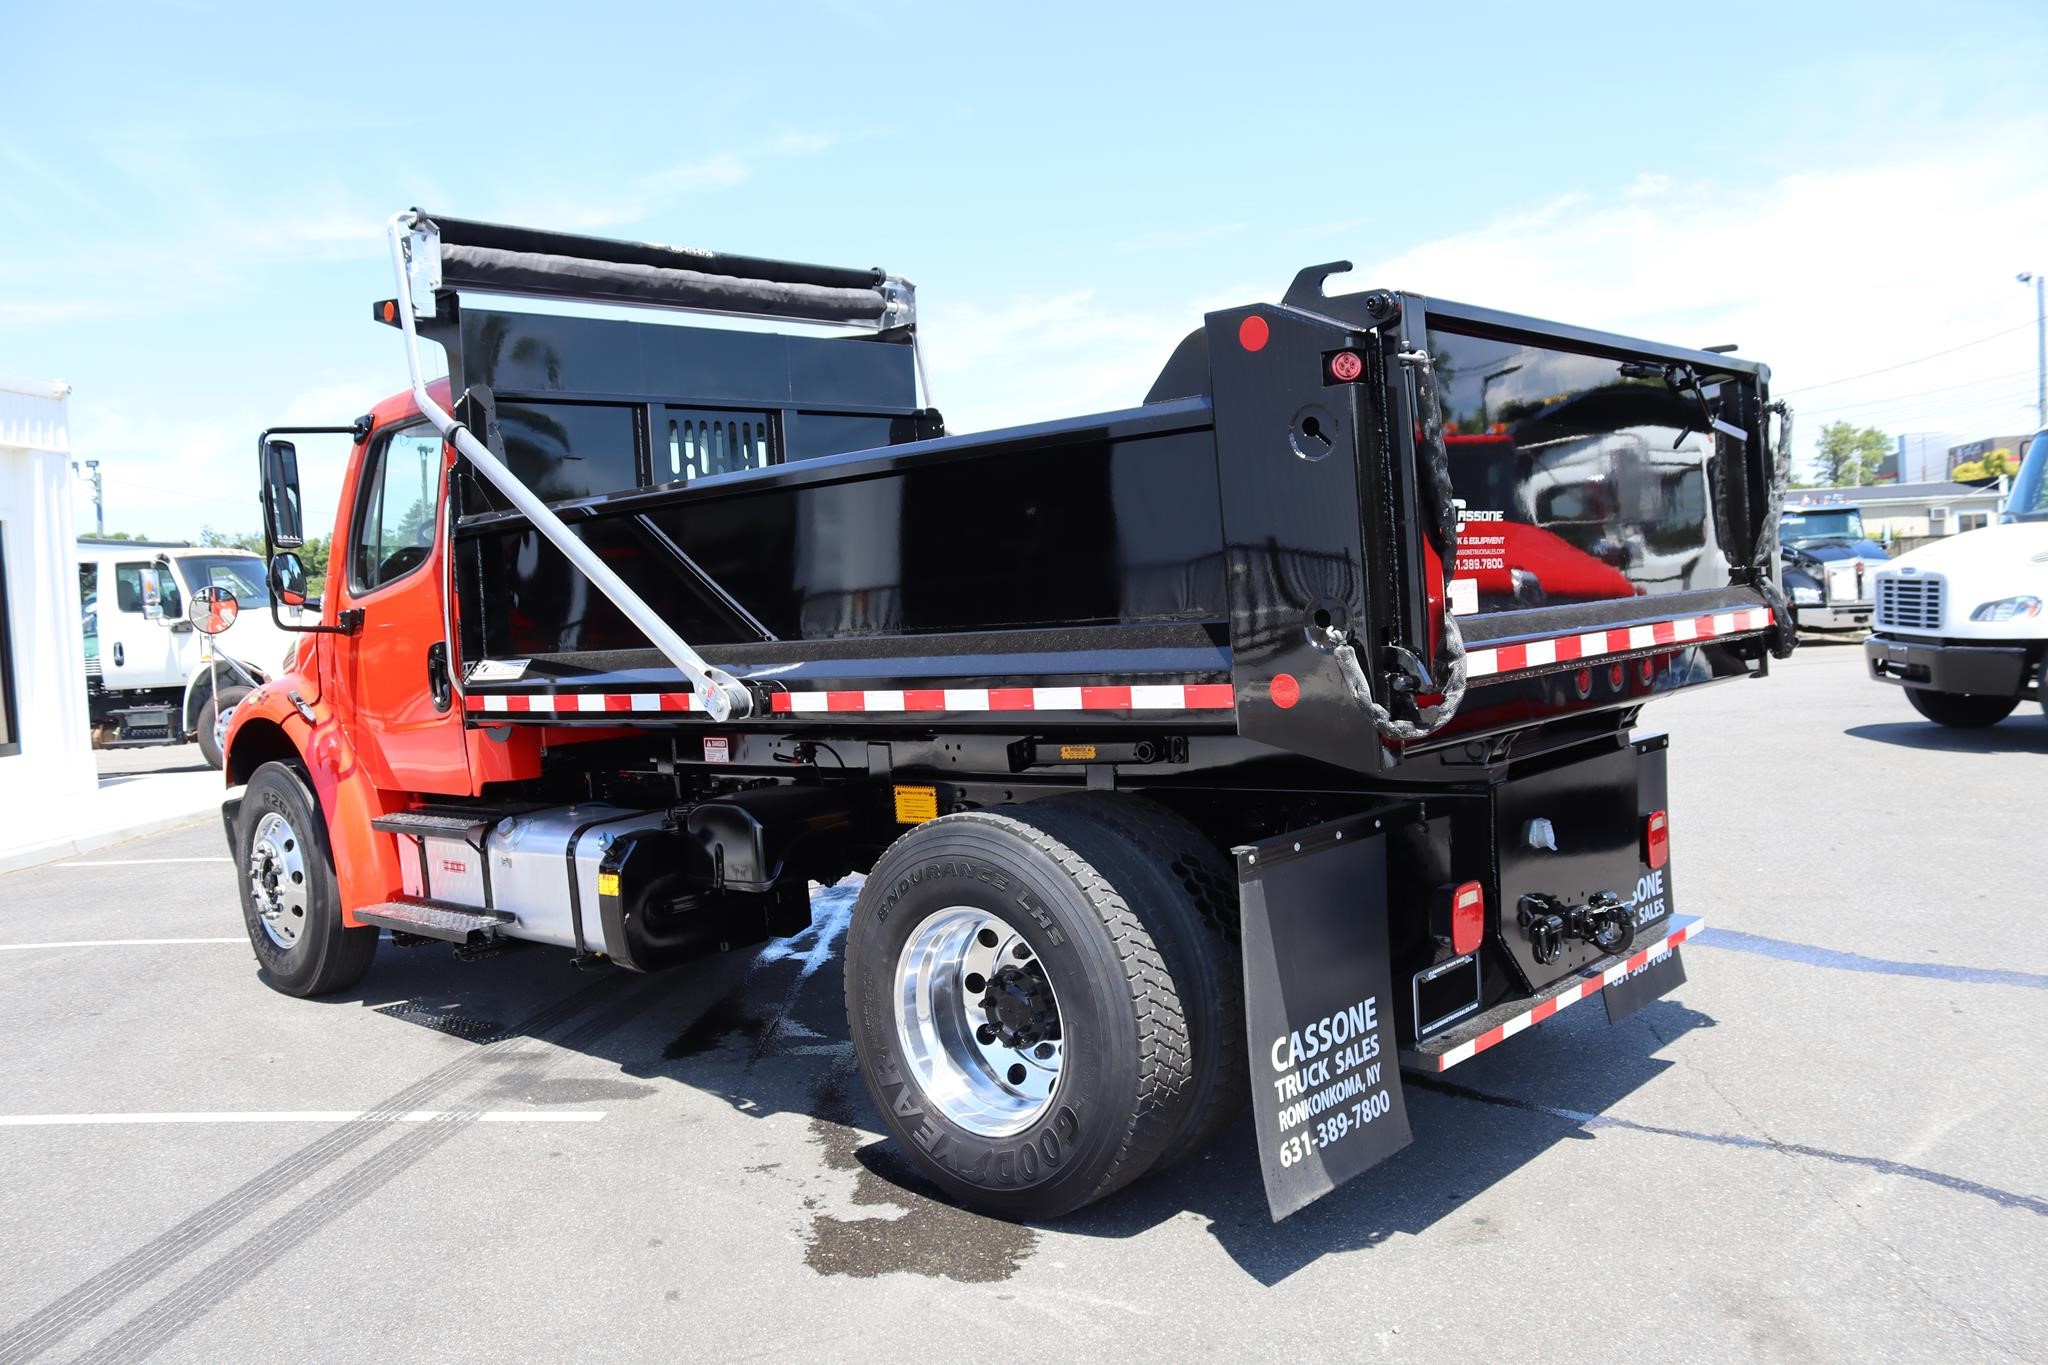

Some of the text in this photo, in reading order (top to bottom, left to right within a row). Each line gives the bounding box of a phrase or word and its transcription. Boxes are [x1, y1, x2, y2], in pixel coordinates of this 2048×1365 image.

[1454, 558, 1504, 571] 1.389.7800
[1469, 537, 1505, 545] EQUIPMENT
[877, 862, 1065, 948] ENDURANCE LHS
[1639, 898, 1665, 925] SALES
[1272, 997, 1378, 1072] CASSONE
[1274, 1034, 1380, 1103] TRUCK SALES
[876, 1052, 1080, 1186] GOODYEAR
[1278, 1062, 1382, 1132] RONKONKOMA, NY
[1279, 1089, 1391, 1168] 631-389-7800
